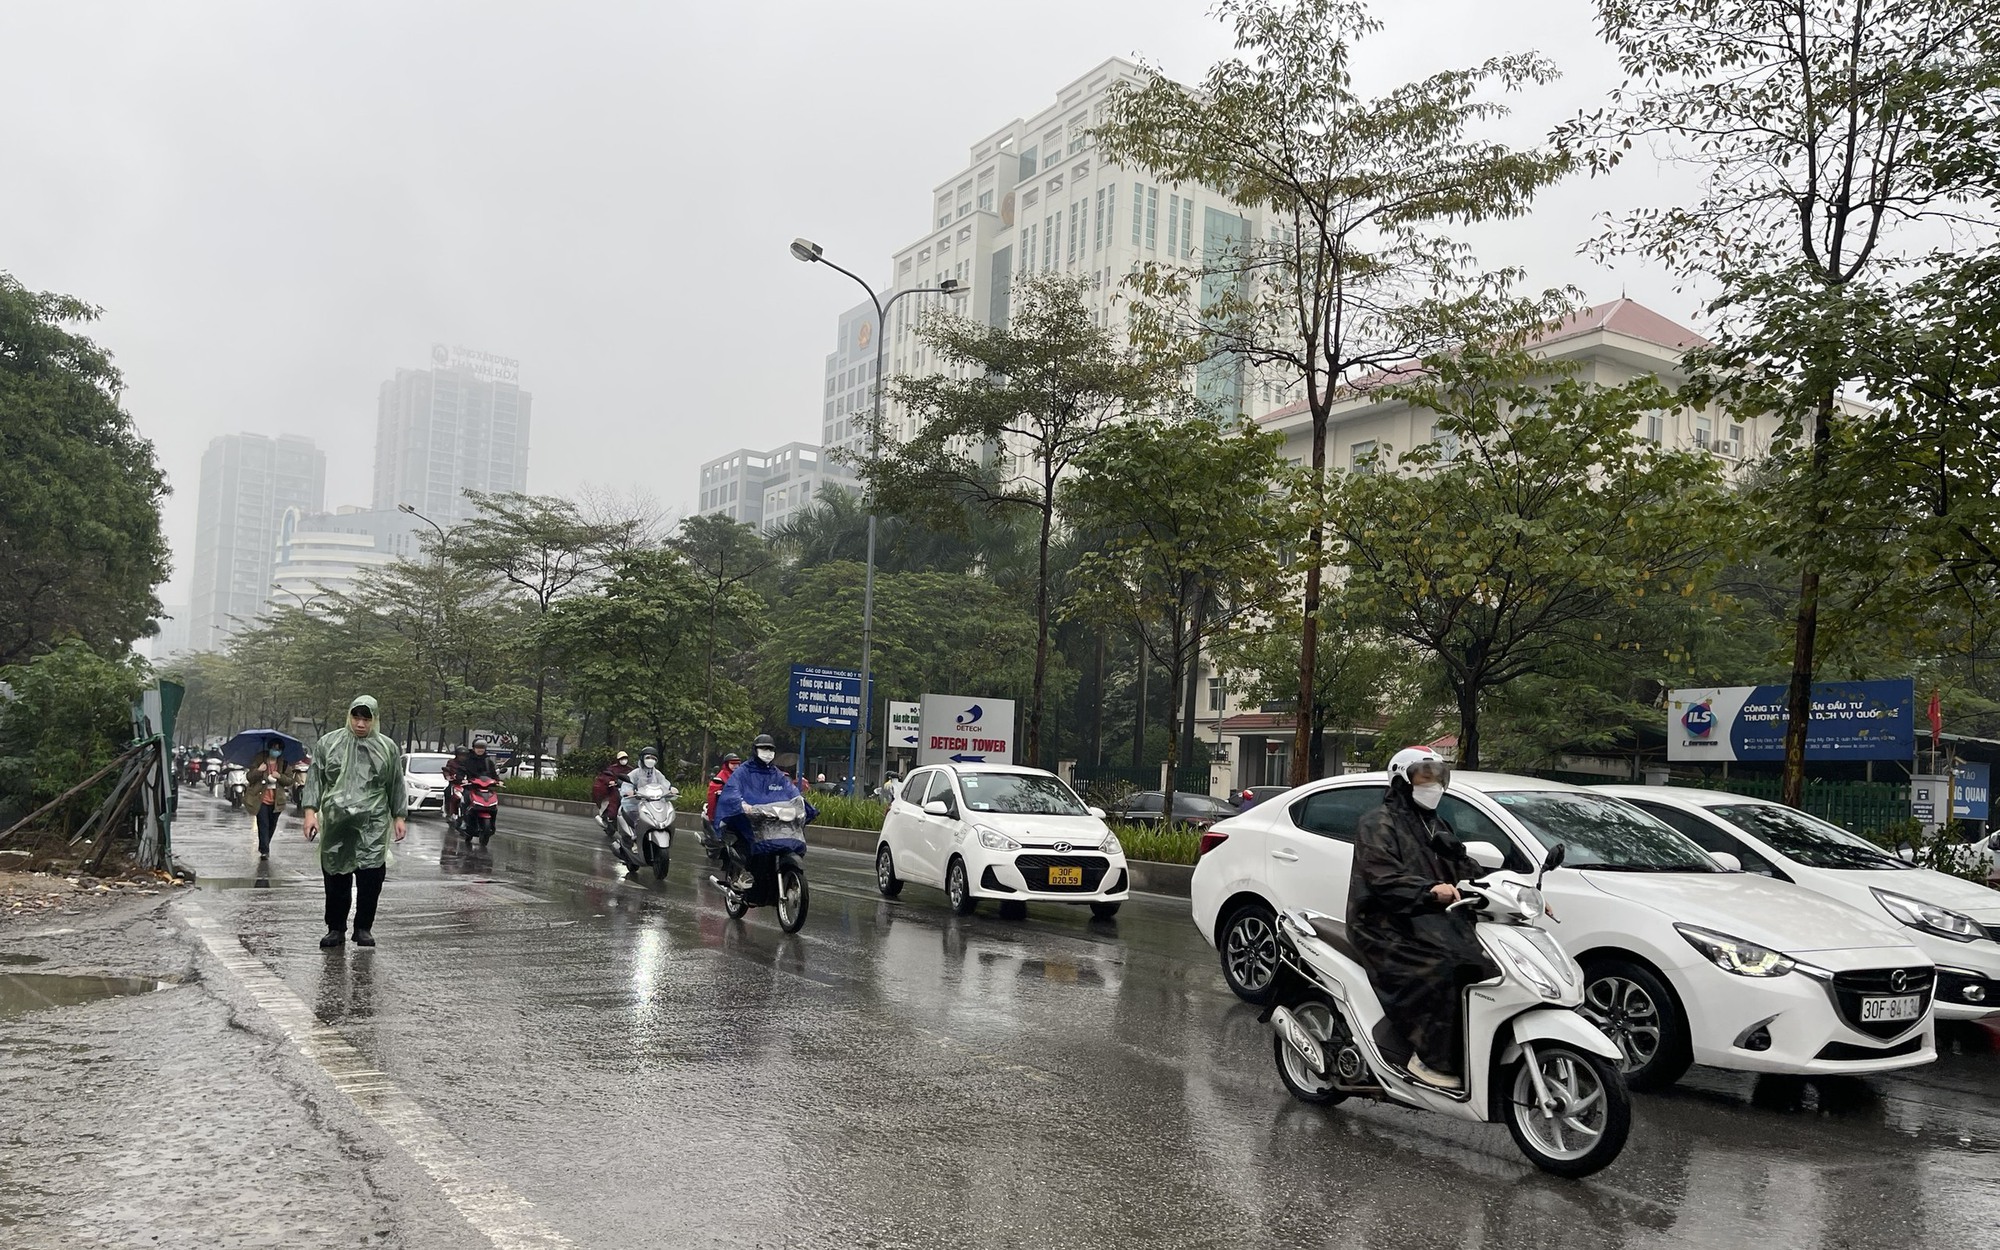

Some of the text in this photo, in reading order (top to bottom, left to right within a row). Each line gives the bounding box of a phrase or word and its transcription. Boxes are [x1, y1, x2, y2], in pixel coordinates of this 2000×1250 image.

[813, 680, 824, 690] CỤC
[835, 680, 843, 691] SỐ
[798, 691, 809, 701] CỤC
[797, 703, 808, 713] CỤC
[1743, 704, 1767, 713] CÔNG
[1850, 702, 1863, 710] TƯ
[1687, 711, 1711, 723] ILS
[1840, 711, 1853, 720] VỤ
[956, 724, 982, 732] DETECH
[930, 736, 1006, 753] DETECH TOWER
[1211, 776, 1218, 785] 12
[1965, 786, 1987, 803] QUAN
[1058, 868, 1073, 876] 30F
[1474, 991, 1496, 1002] HONDA
